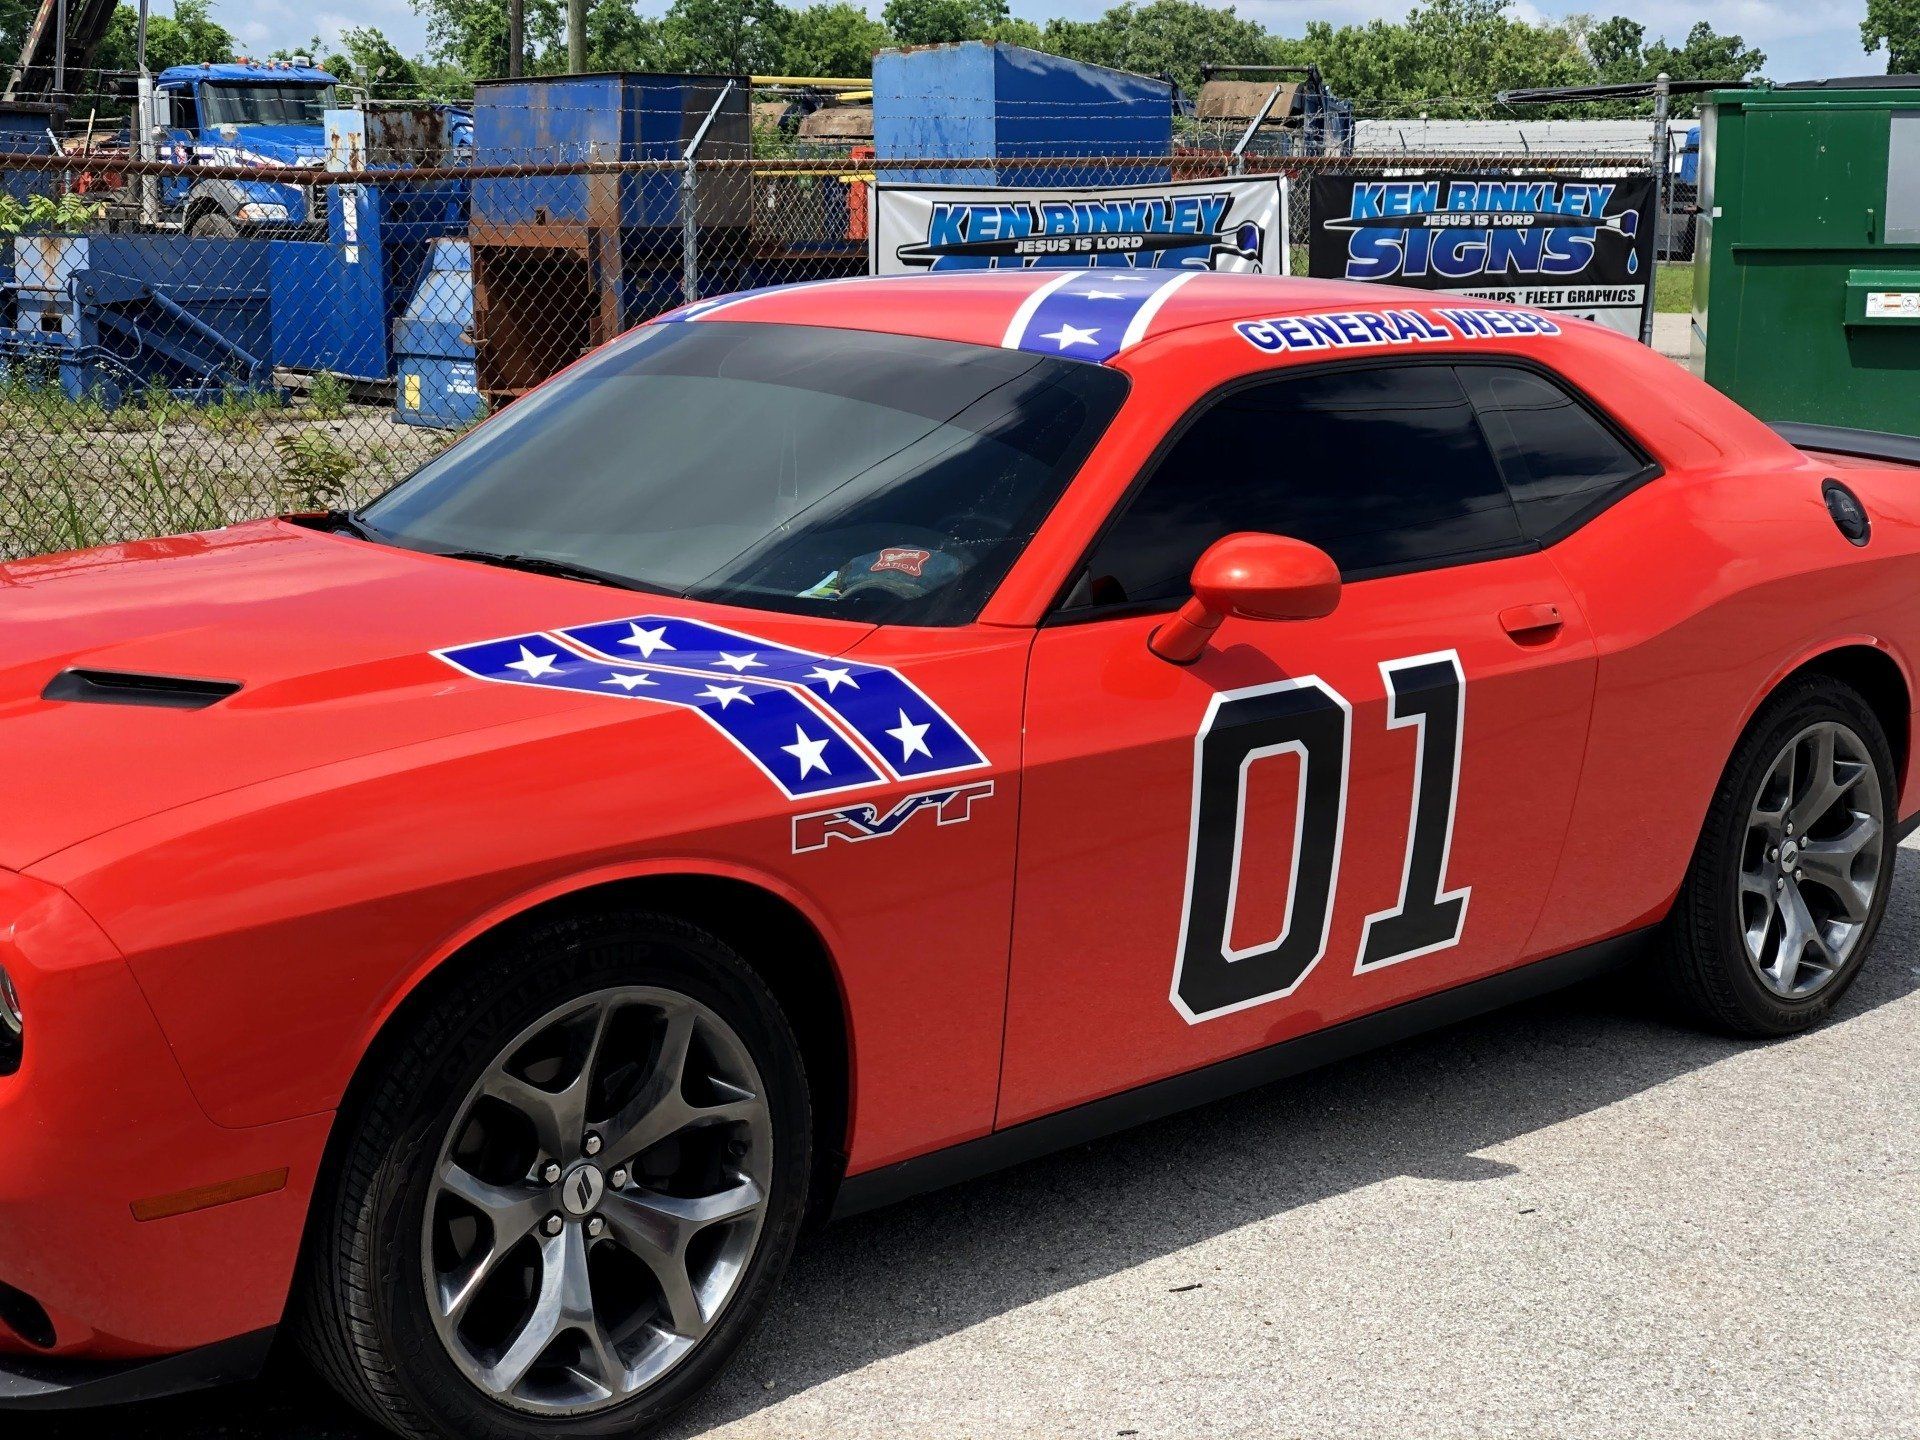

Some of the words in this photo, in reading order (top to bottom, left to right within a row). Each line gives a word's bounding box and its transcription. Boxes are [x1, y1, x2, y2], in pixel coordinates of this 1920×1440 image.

[1350, 182, 1437, 220] KEN
[1448, 182, 1615, 219] BINKLEY
[1423, 214, 1471, 226] JESUS
[1474, 214, 1489, 226] IS
[1493, 214, 1534, 226] LORD
[929, 203, 1032, 247] KEN
[1043, 195, 1230, 236] BINKLEY
[1014, 239, 1071, 254] JESUS
[1075, 238, 1092, 252] IS
[1097, 236, 1144, 250] LORD
[1346, 225, 1598, 280] SIGNS
[1525, 290, 1564, 304] FLEET
[1567, 289, 1636, 304] GRAPHICS
[1233, 309, 1454, 354] GENERAL
[1432, 308, 1562, 340] WEBB
[877, 562, 918, 572] NATION
[1169, 648, 1472, 1026] 01
